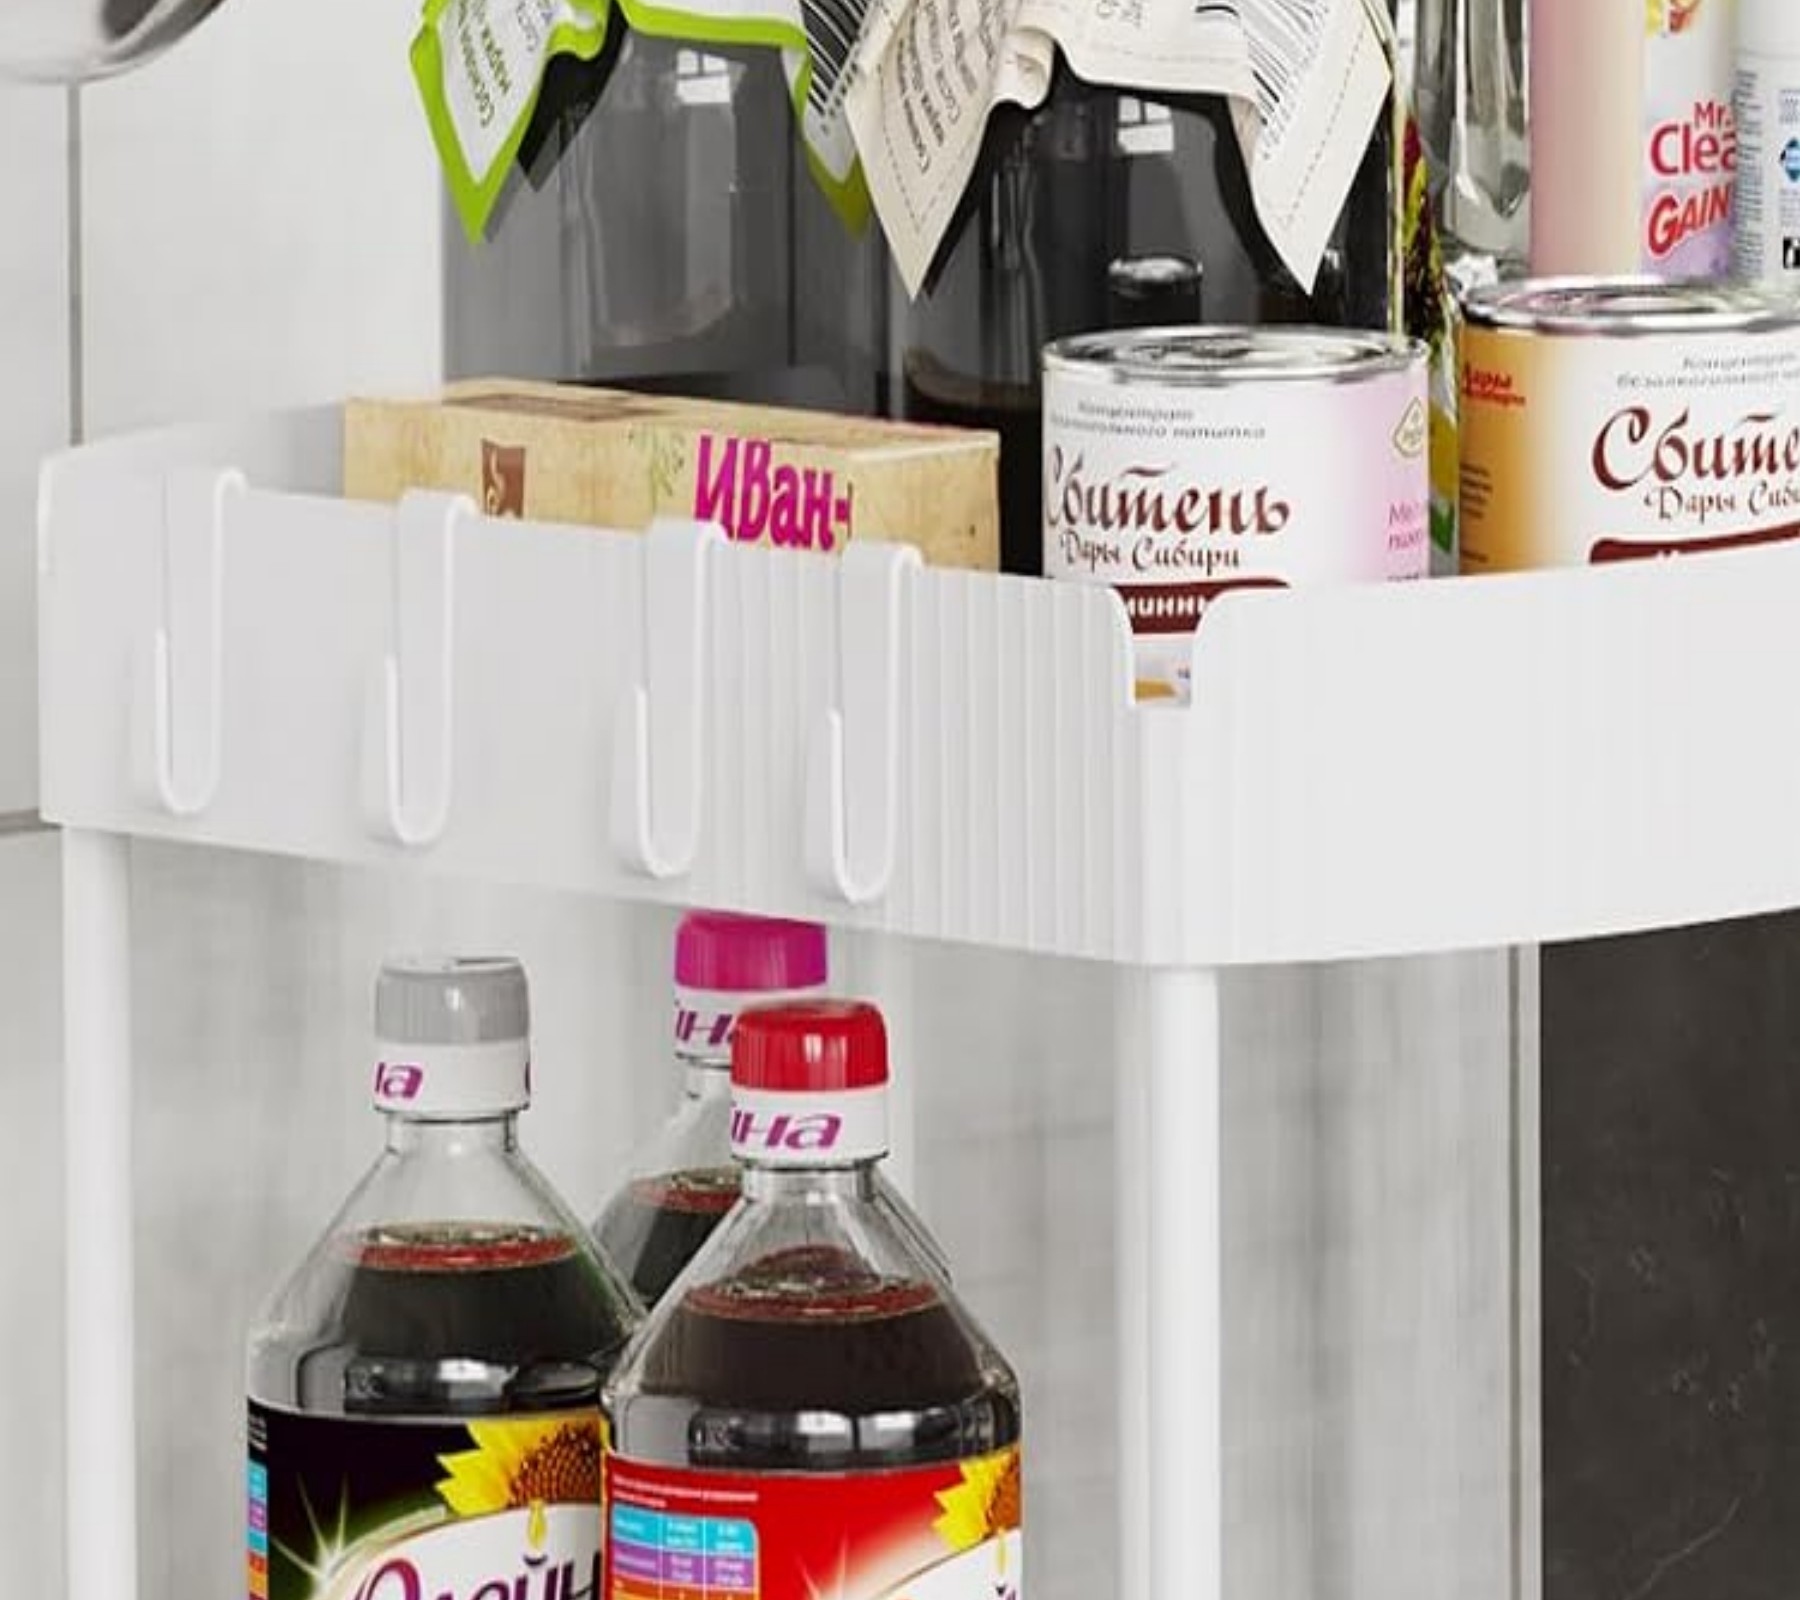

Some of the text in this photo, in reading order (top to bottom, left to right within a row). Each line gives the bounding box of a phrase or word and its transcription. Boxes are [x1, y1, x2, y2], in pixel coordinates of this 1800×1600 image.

[1693, 99, 1734, 130] Mr.
[1650, 120, 1738, 177] Clea
[1649, 184, 1731, 255] GAIN
[1643, 480, 1738, 525] Дары
[1131, 534, 1241, 578] Сибири
